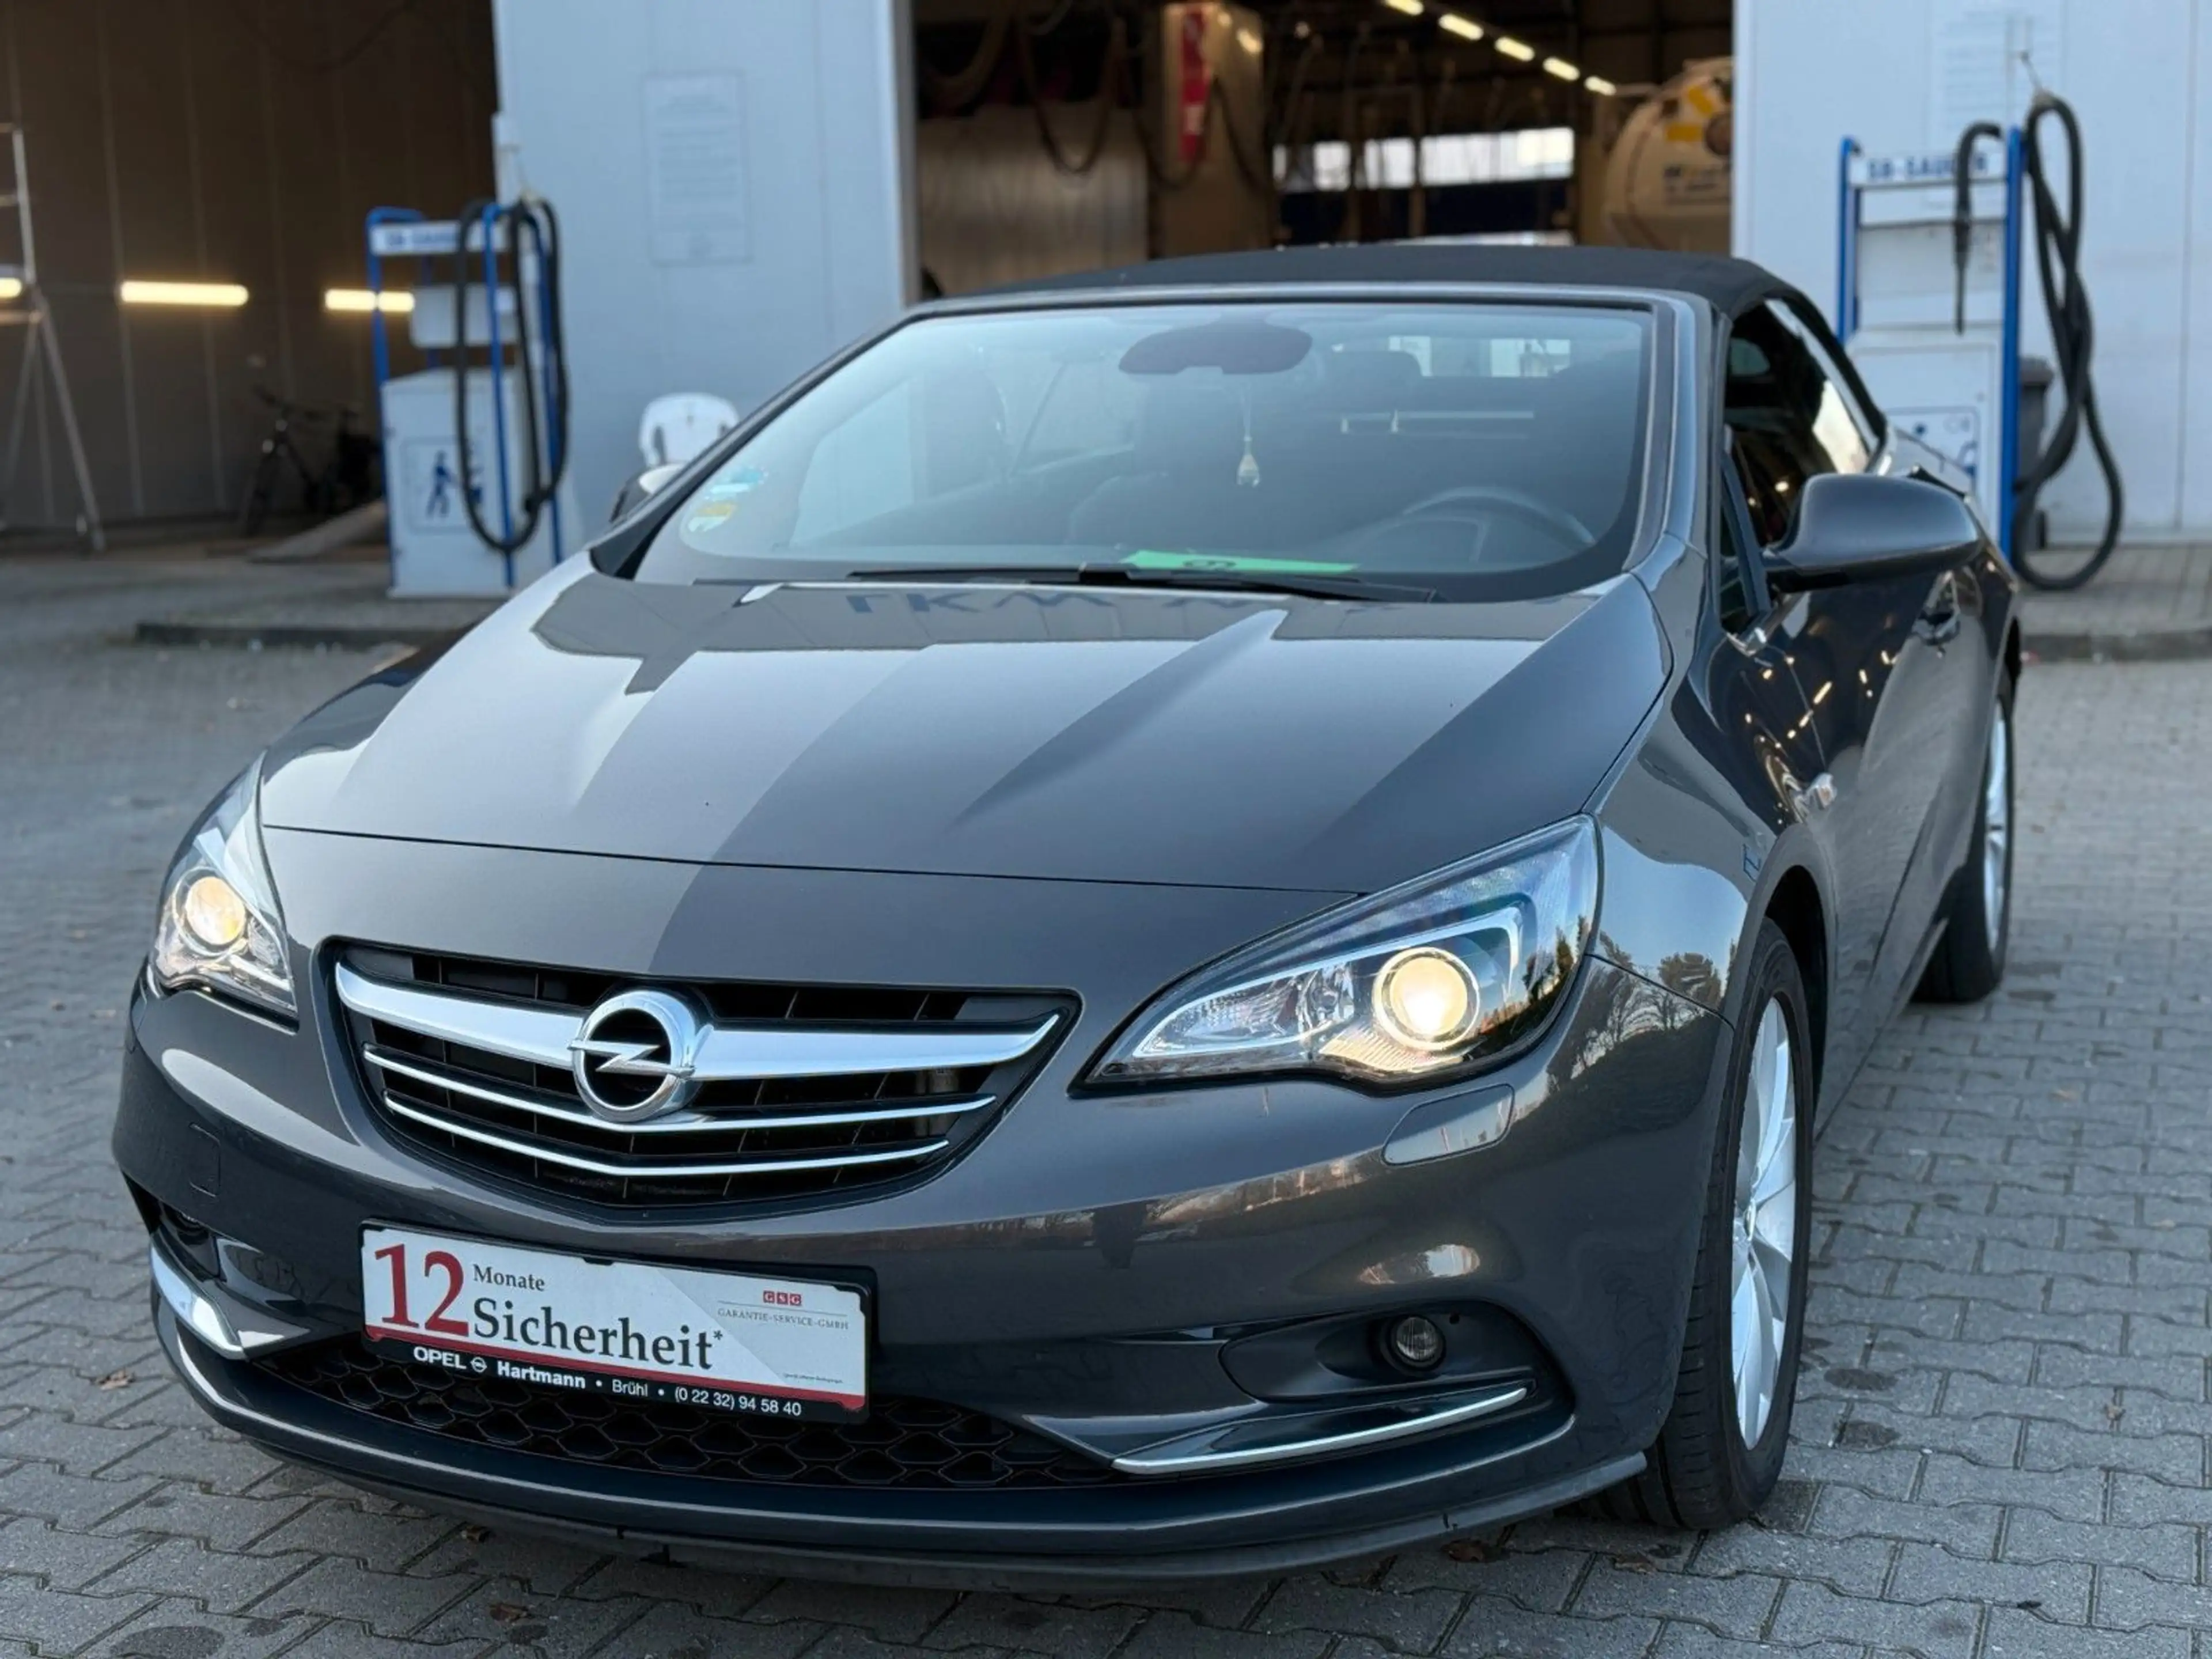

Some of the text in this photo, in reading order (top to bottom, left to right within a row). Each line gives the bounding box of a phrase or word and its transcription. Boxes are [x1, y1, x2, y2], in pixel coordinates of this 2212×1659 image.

[374, 1243, 469, 1337] 12
[473, 1264, 546, 1291] Monate
[414, 1346, 802, 1416] OPEL Hartmann Brühl (0 22 32) 94 58 40
